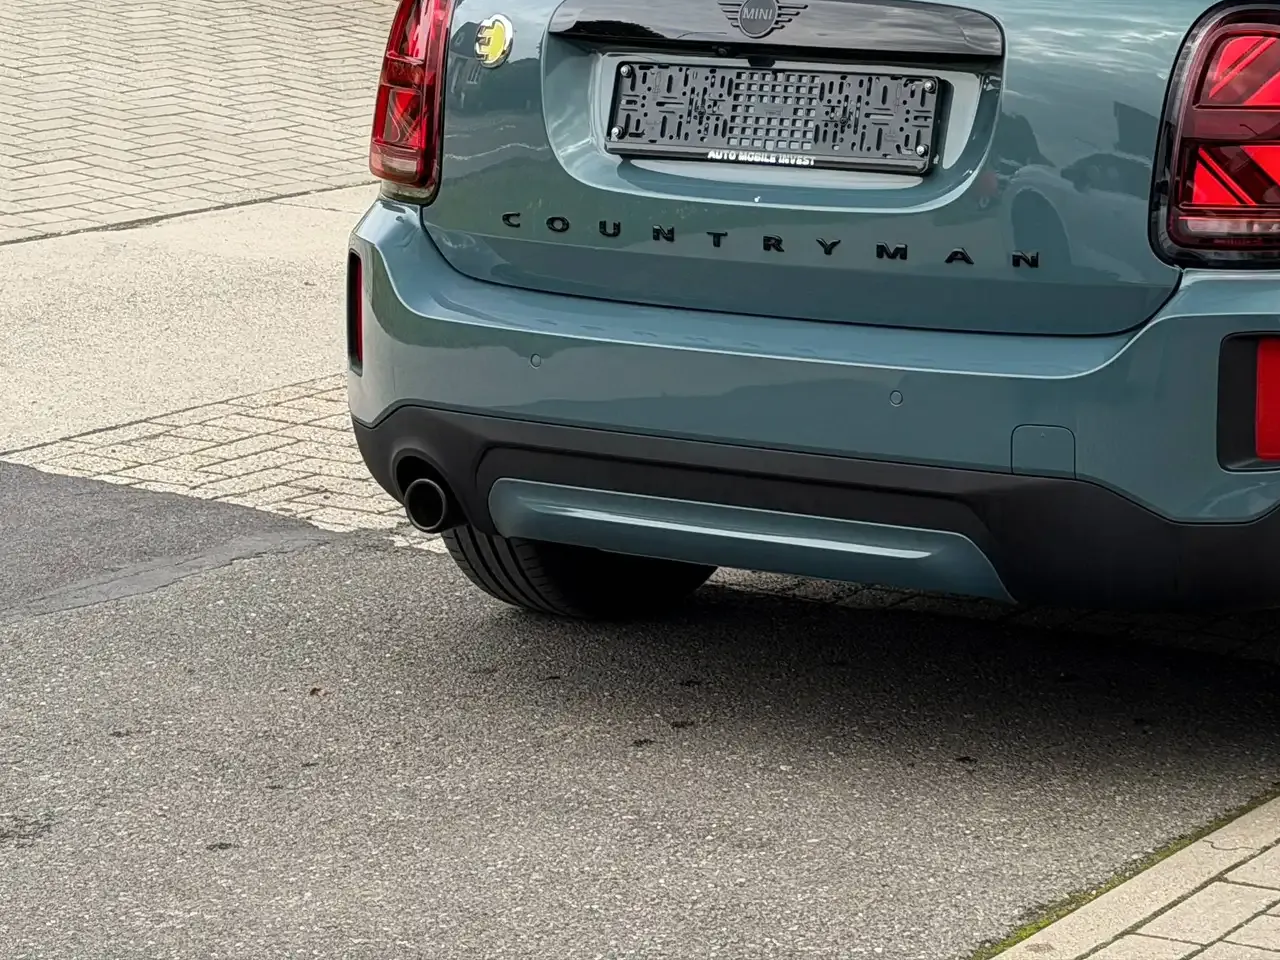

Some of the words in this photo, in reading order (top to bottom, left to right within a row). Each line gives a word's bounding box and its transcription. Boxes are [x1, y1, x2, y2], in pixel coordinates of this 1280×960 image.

[743, 7, 773, 20] MINI
[707, 150, 736, 160] AUTO
[738, 152, 776, 163] MOBILE
[778, 154, 816, 166] INVEST
[502, 212, 1039, 268] COUNTRYMAN
